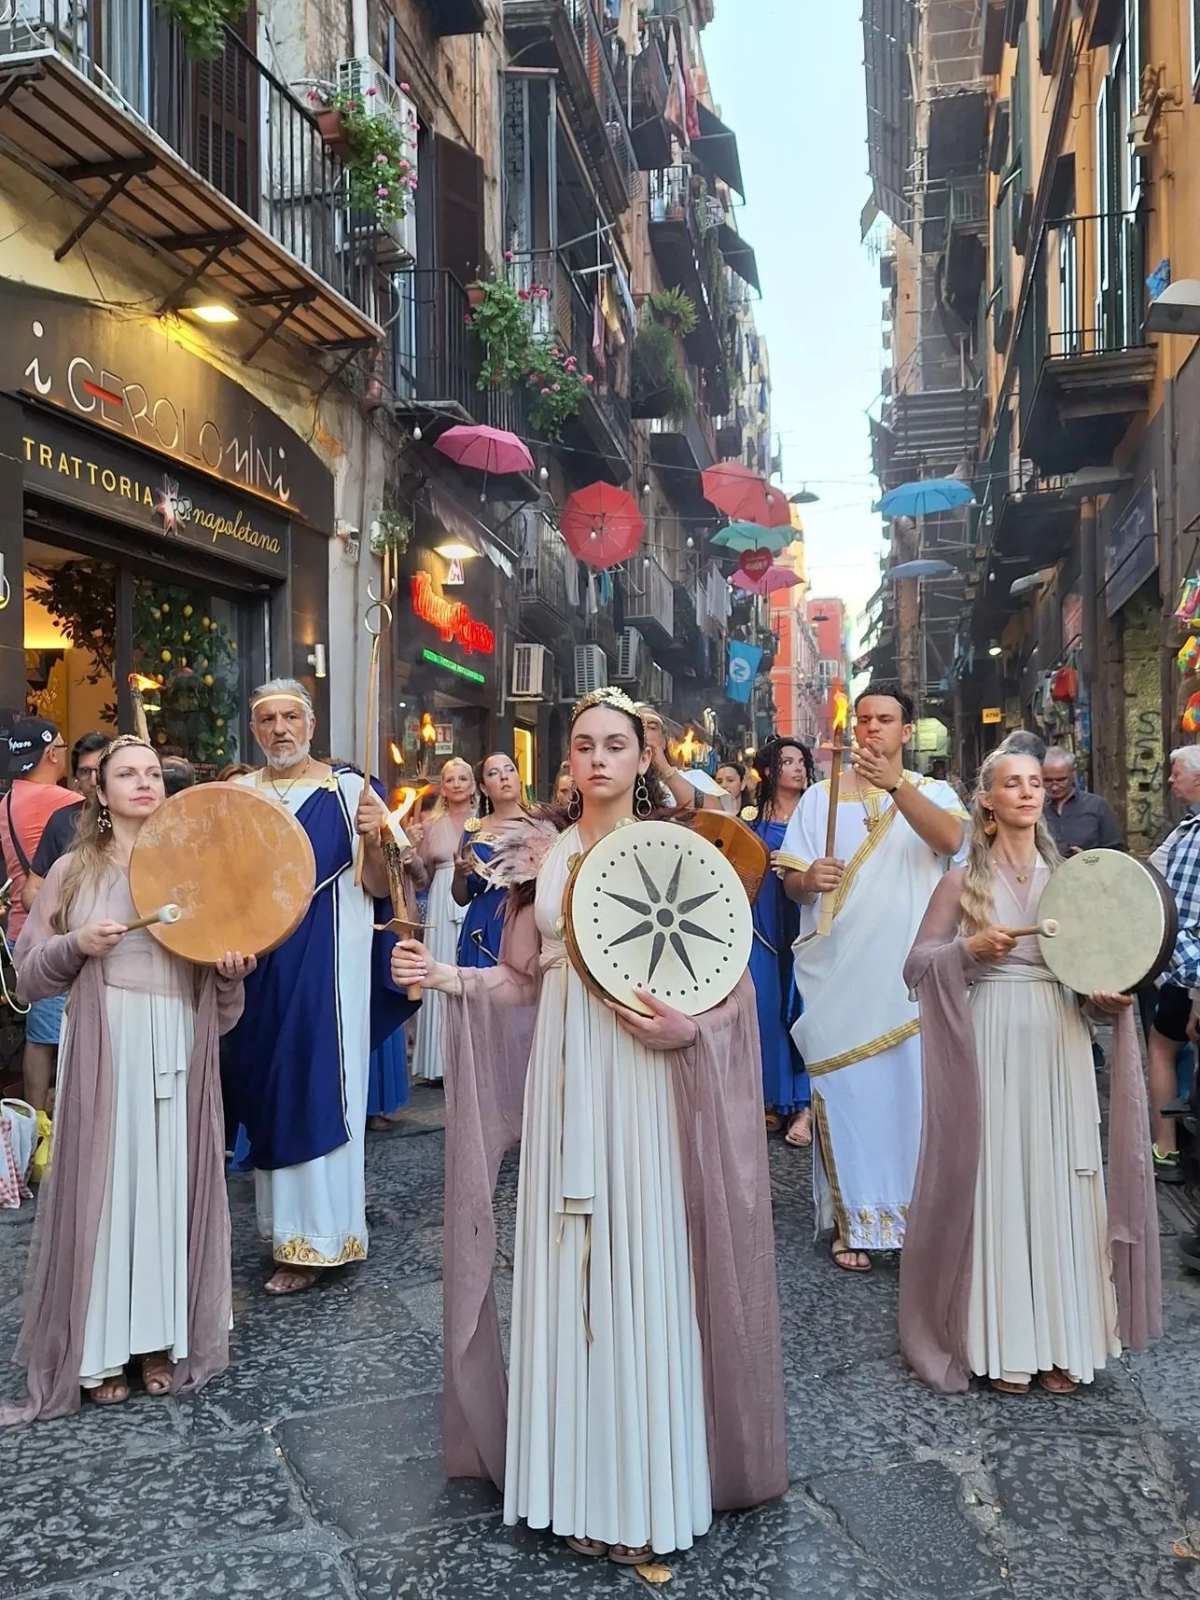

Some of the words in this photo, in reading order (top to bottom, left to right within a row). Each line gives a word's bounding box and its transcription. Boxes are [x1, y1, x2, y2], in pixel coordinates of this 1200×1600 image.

[24, 320, 53, 395] i
[22, 436, 155, 508] TRATTORIA
[193, 509, 281, 554] napoletana
